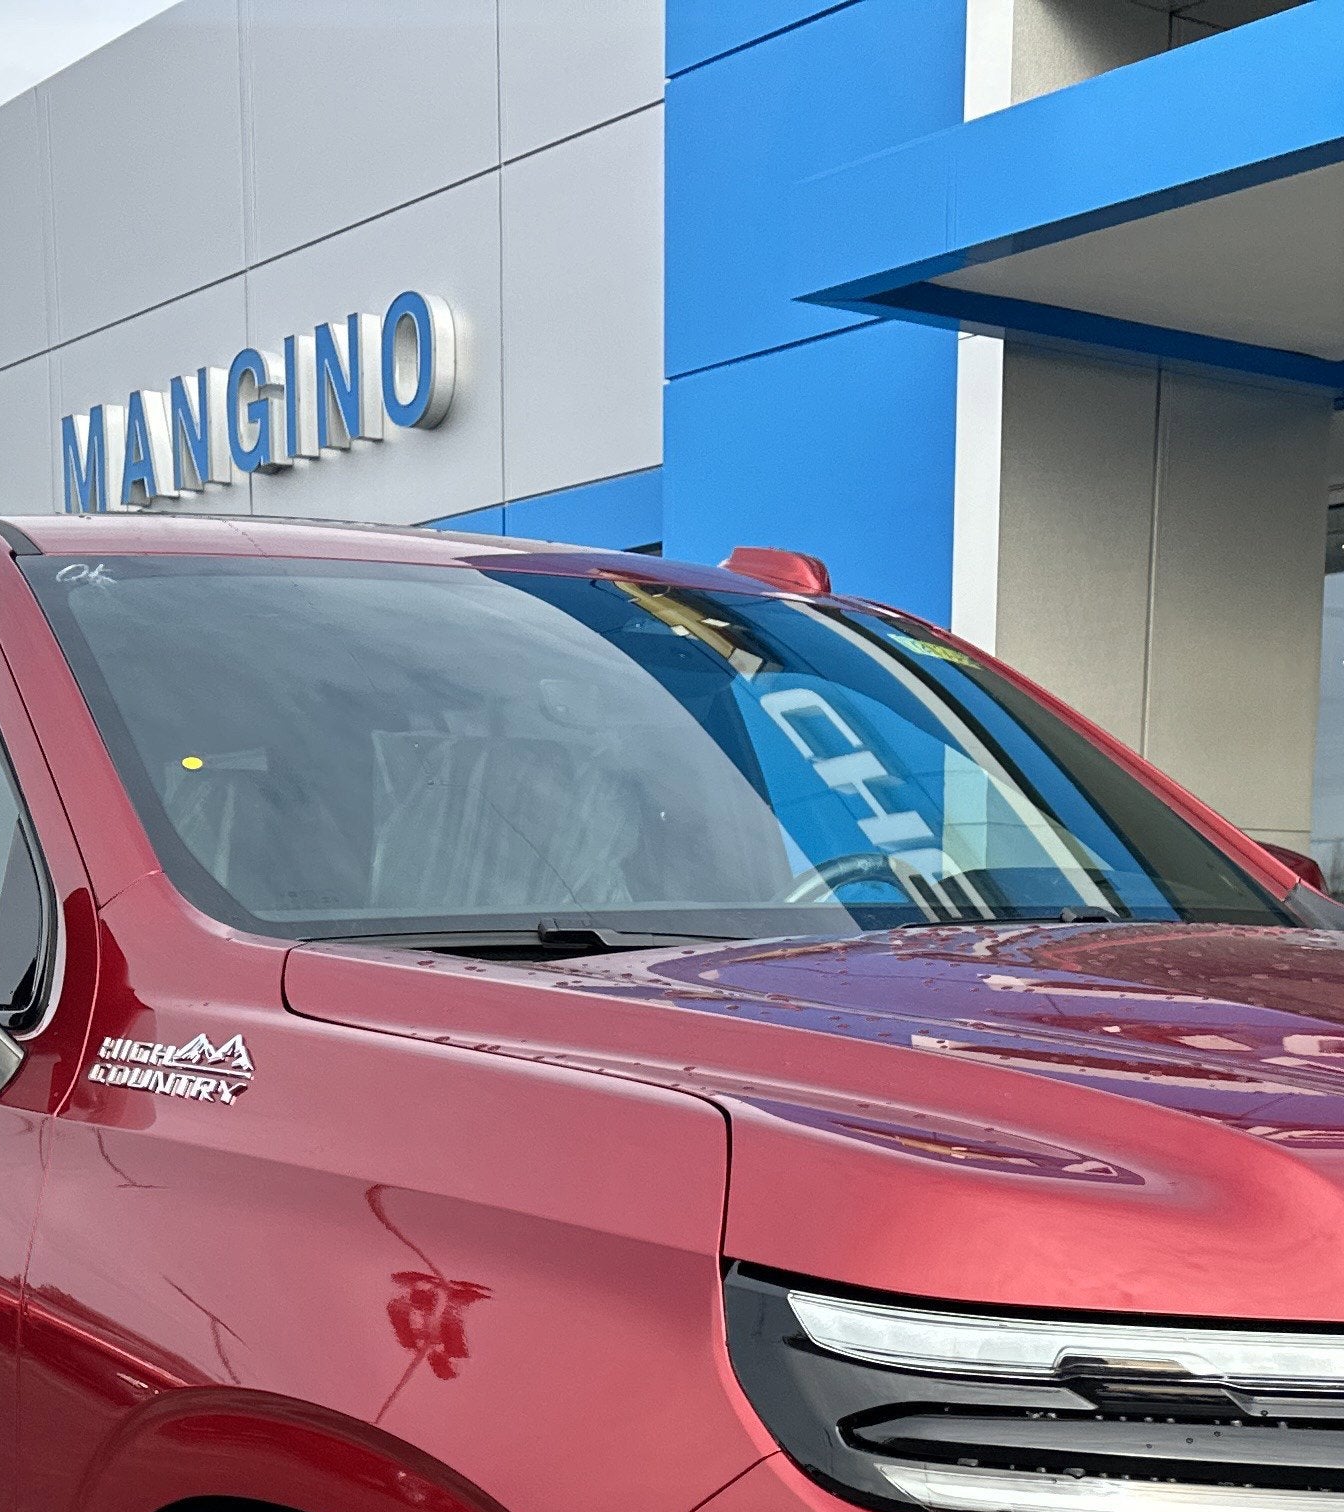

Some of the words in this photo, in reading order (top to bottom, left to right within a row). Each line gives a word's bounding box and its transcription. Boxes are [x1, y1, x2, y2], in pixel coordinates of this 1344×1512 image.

[62, 290, 455, 512] MANGINO
[97, 1036, 178, 1067] HIGH
[87, 1063, 248, 1106] COUNTRY
